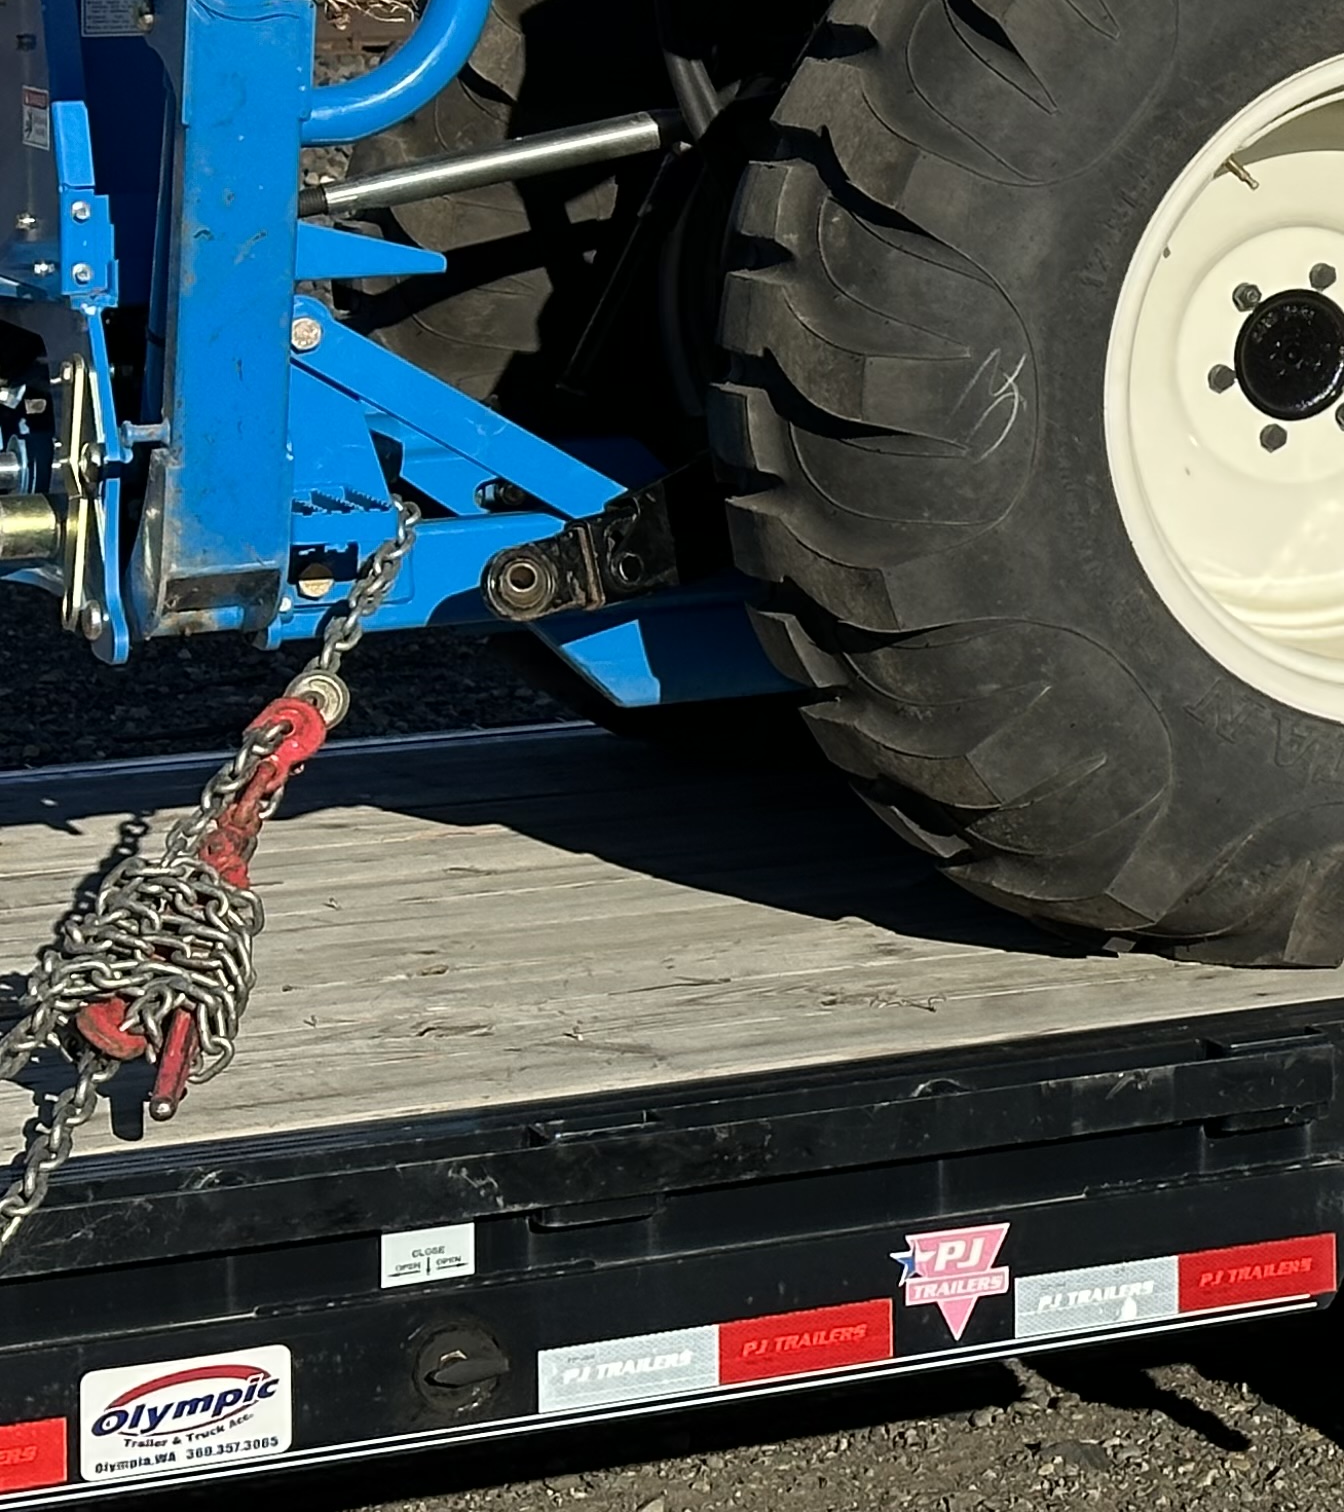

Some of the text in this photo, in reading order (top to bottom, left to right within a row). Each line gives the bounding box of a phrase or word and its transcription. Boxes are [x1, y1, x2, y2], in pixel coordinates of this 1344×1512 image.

[411, 1245, 446, 1258] CLOSE
[933, 1238, 988, 1272] PJ
[912, 1273, 1004, 1301] TRAILERS
[1037, 1279, 1156, 1312] PJ TRAILERS
[742, 1322, 868, 1358] PJ TRAILERS
[562, 1348, 694, 1385] PJ TRAILERS
[91, 1376, 280, 1437] Olympic
[123, 1438, 168, 1448] Trailer
[172, 1436, 183, 1445] &
[187, 1424, 226, 1442] Truck
